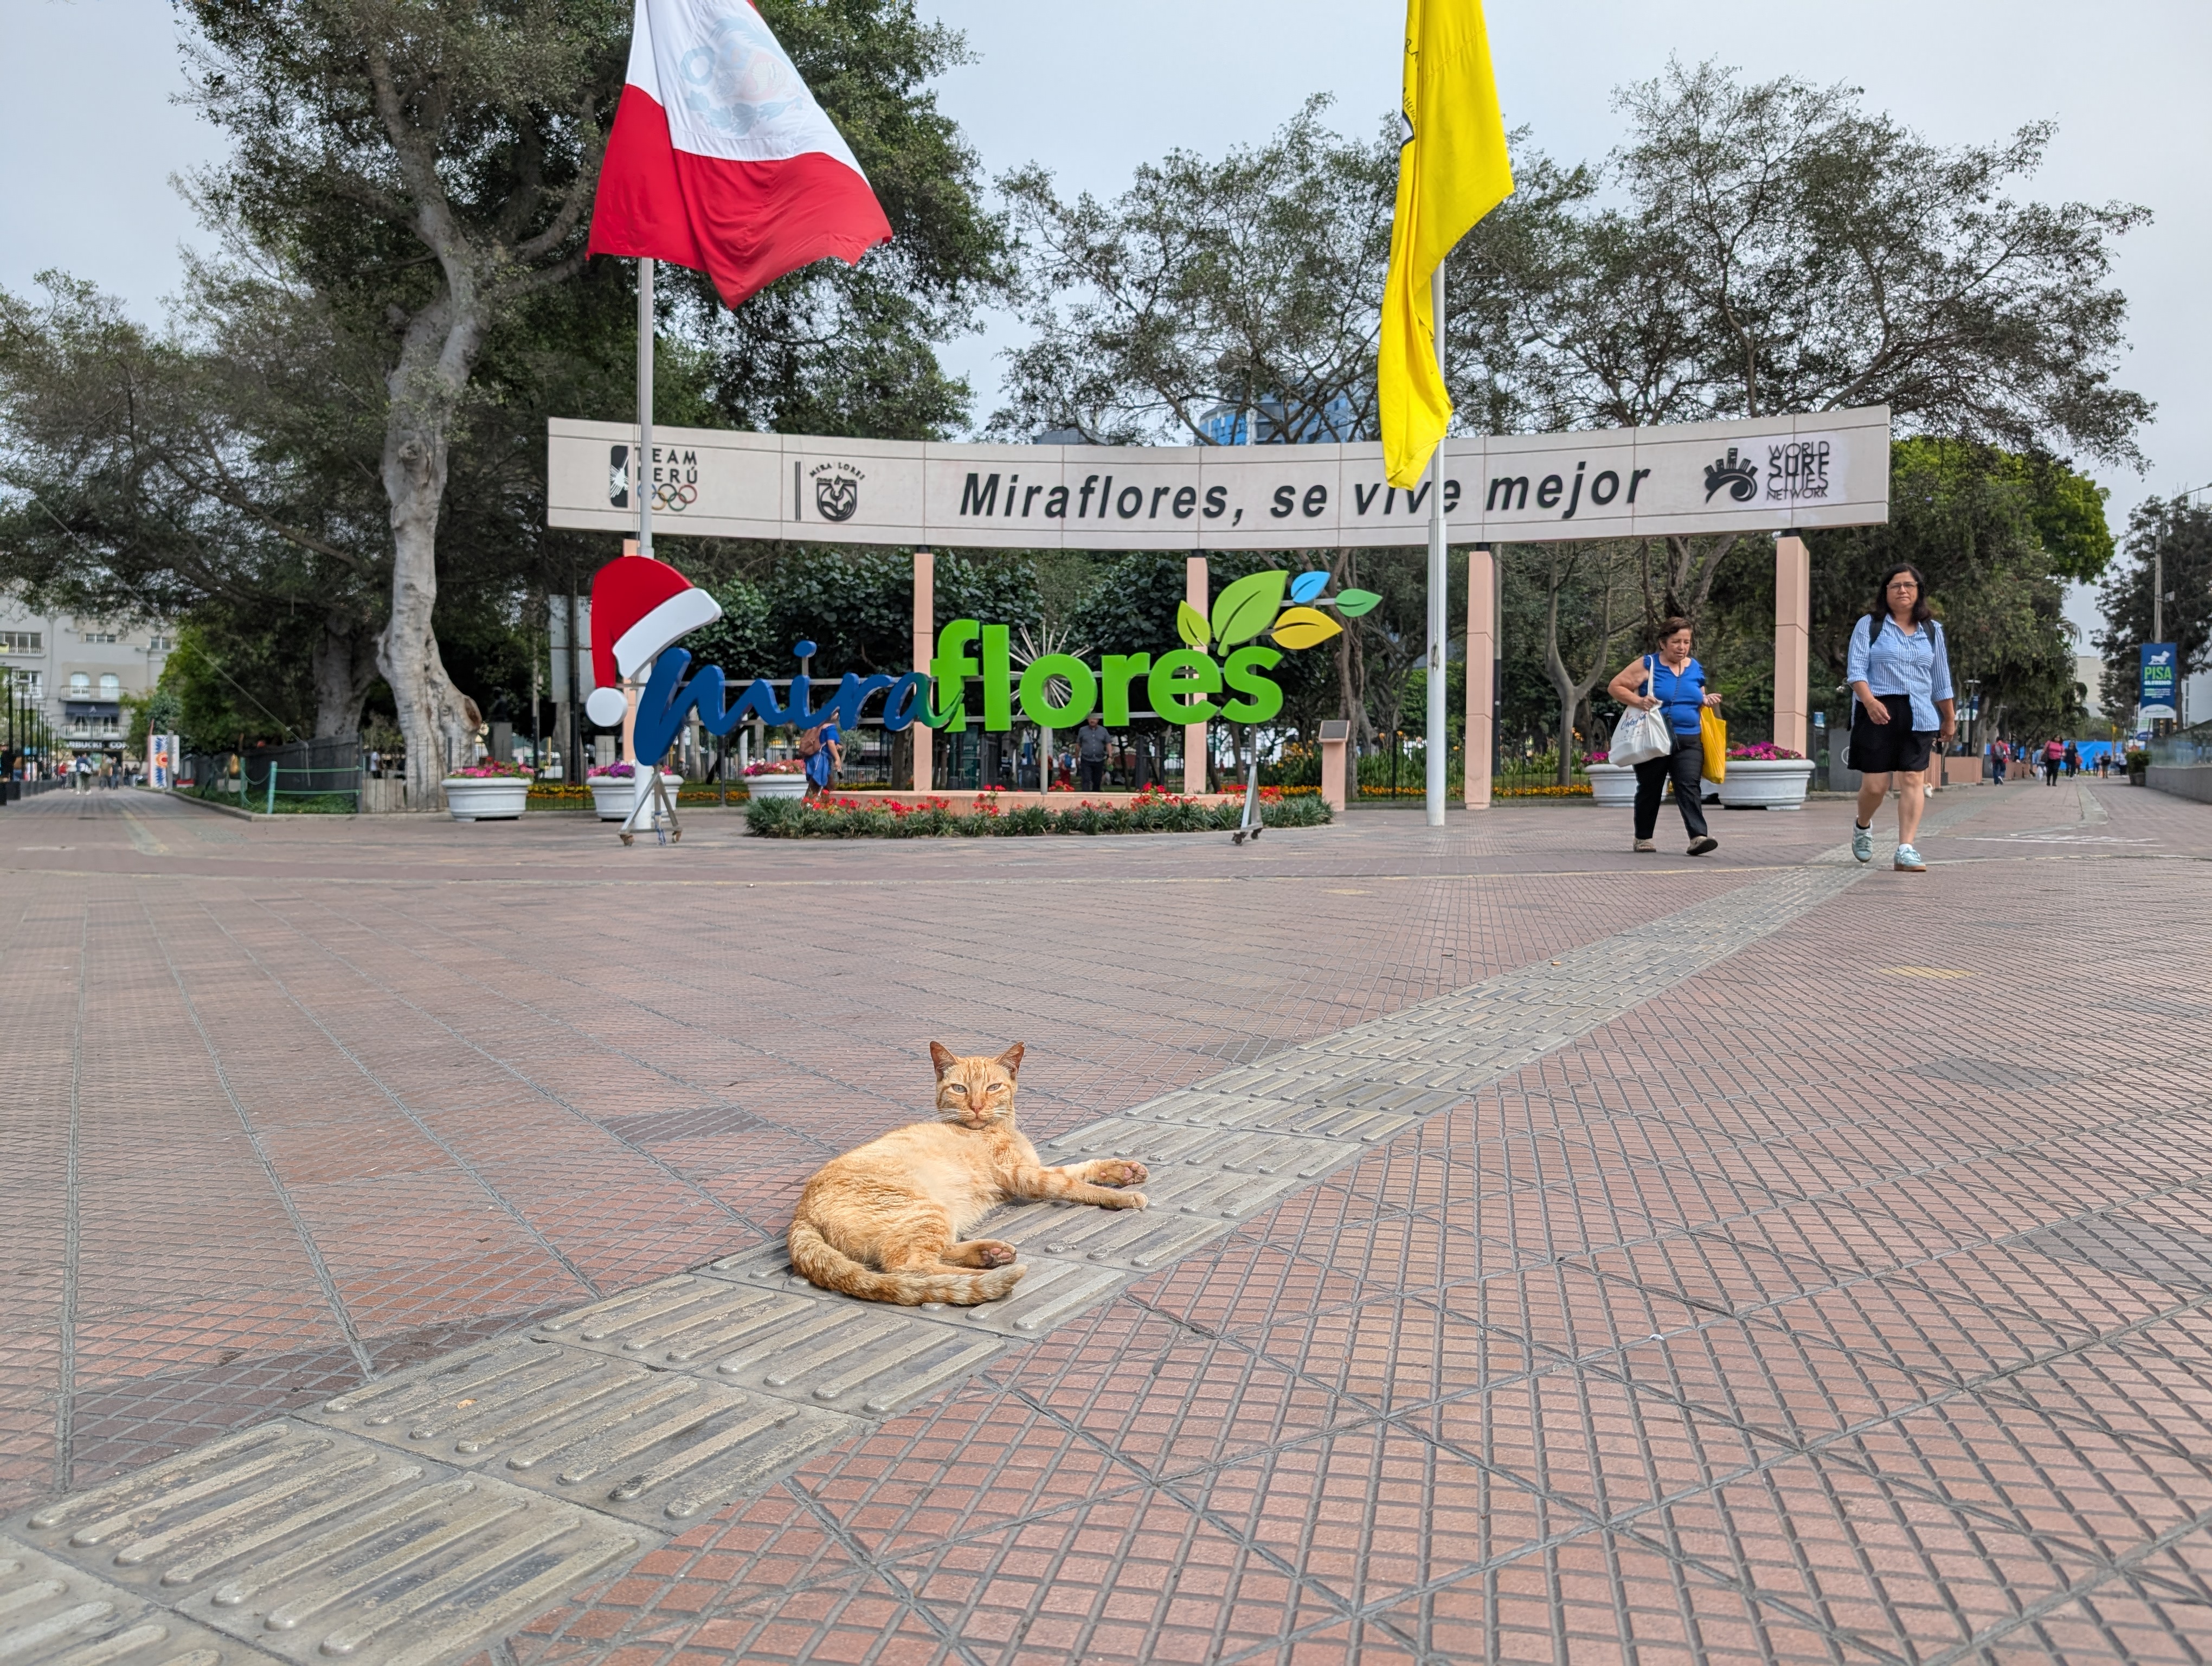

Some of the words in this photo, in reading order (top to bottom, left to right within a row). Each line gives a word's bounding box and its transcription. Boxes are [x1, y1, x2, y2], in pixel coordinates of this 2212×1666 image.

[1768, 440, 1830, 457] WORLD
[1769, 451, 1829, 476] SURF
[1767, 471, 1829, 492] CITIES
[959, 472, 1243, 527] Miraflores,
[1270, 484, 1327, 518] se
[1355, 479, 1461, 515] vive
[1486, 461, 1651, 519] mejor
[1766, 488, 1828, 501] NETWORK
[2144, 666, 2172, 680] PISA
